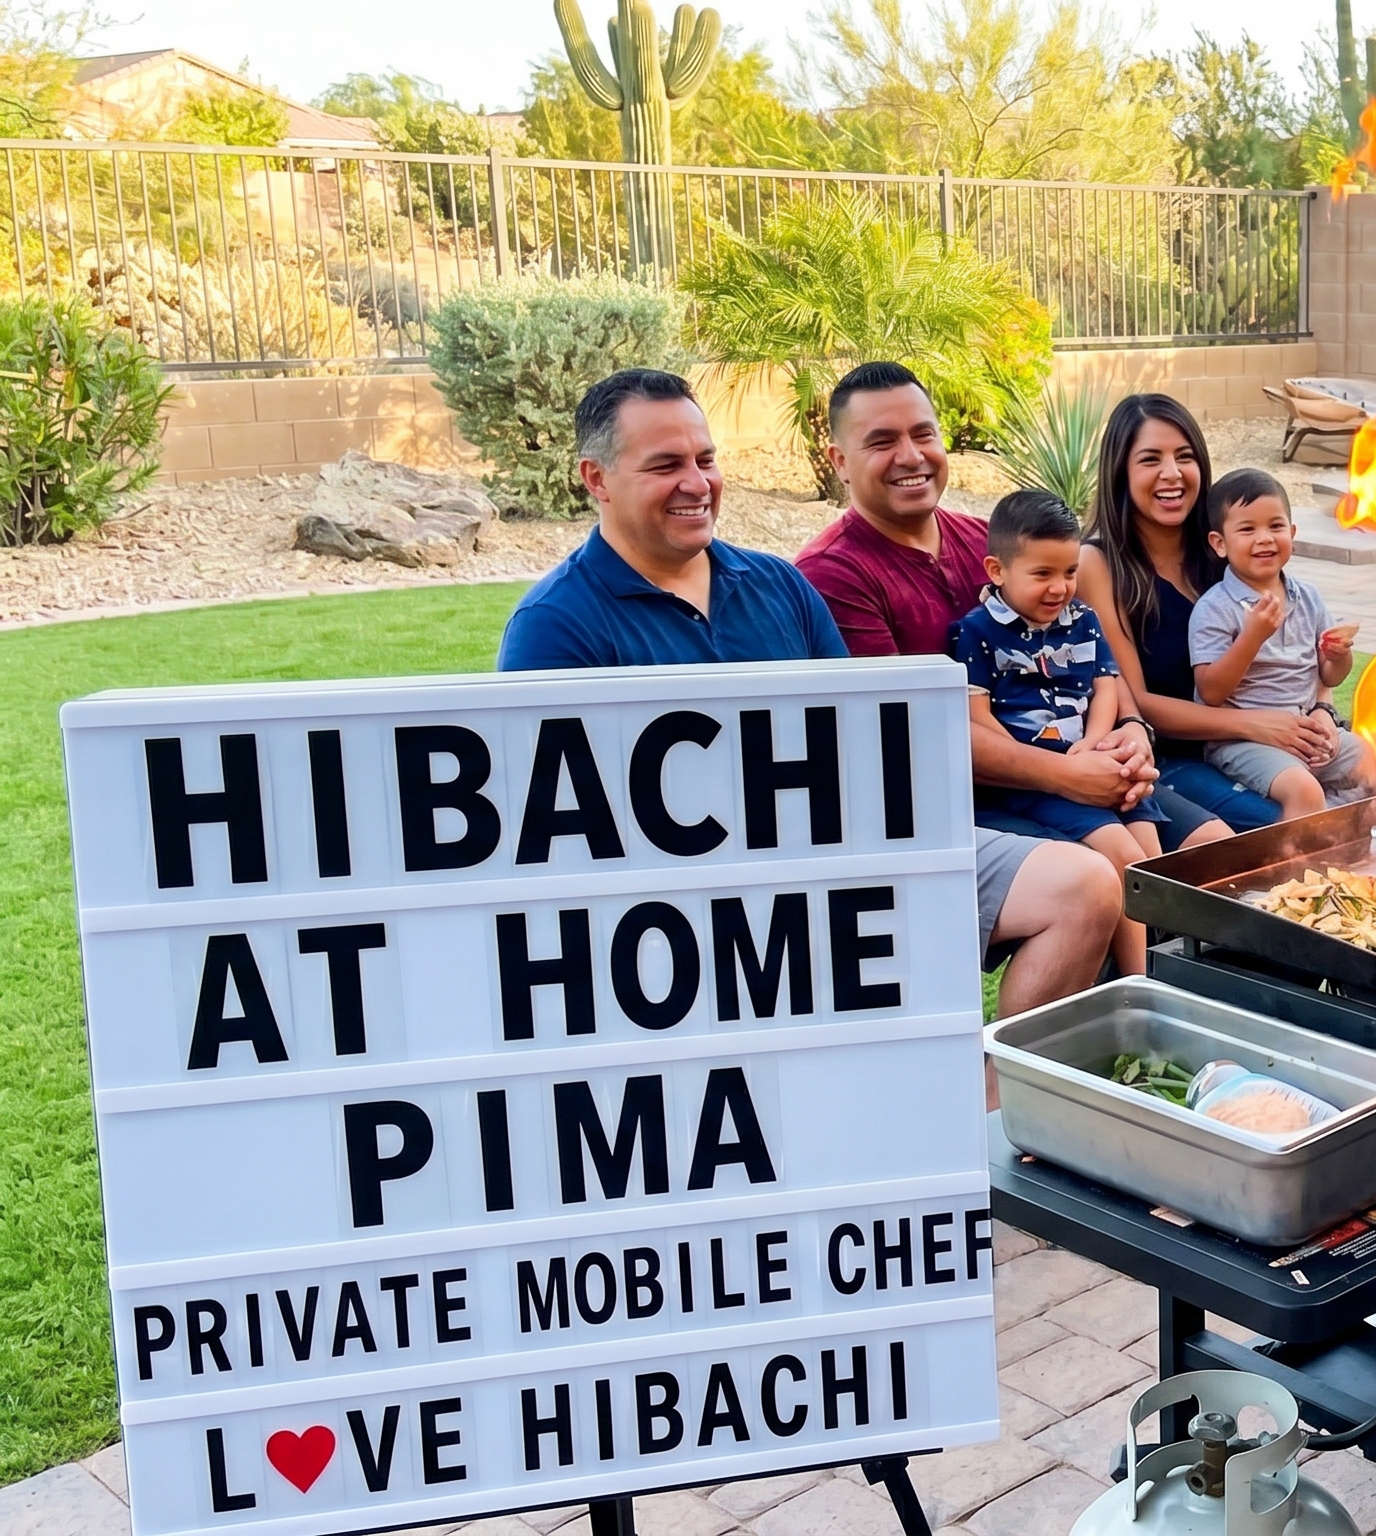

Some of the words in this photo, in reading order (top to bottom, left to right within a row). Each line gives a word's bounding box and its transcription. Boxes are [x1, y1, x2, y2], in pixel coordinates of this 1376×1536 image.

[145, 702, 914, 888] HIBACHI
[188, 923, 386, 1070] AT
[496, 886, 901, 1040] HOME
[344, 1067, 776, 1227] PIMA
[134, 1268, 471, 1380] PRIVATE
[517, 1231, 791, 1332] MOBILE
[828, 1209, 991, 1294] CHEF
[521, 1342, 907, 1470] HIBACHI
